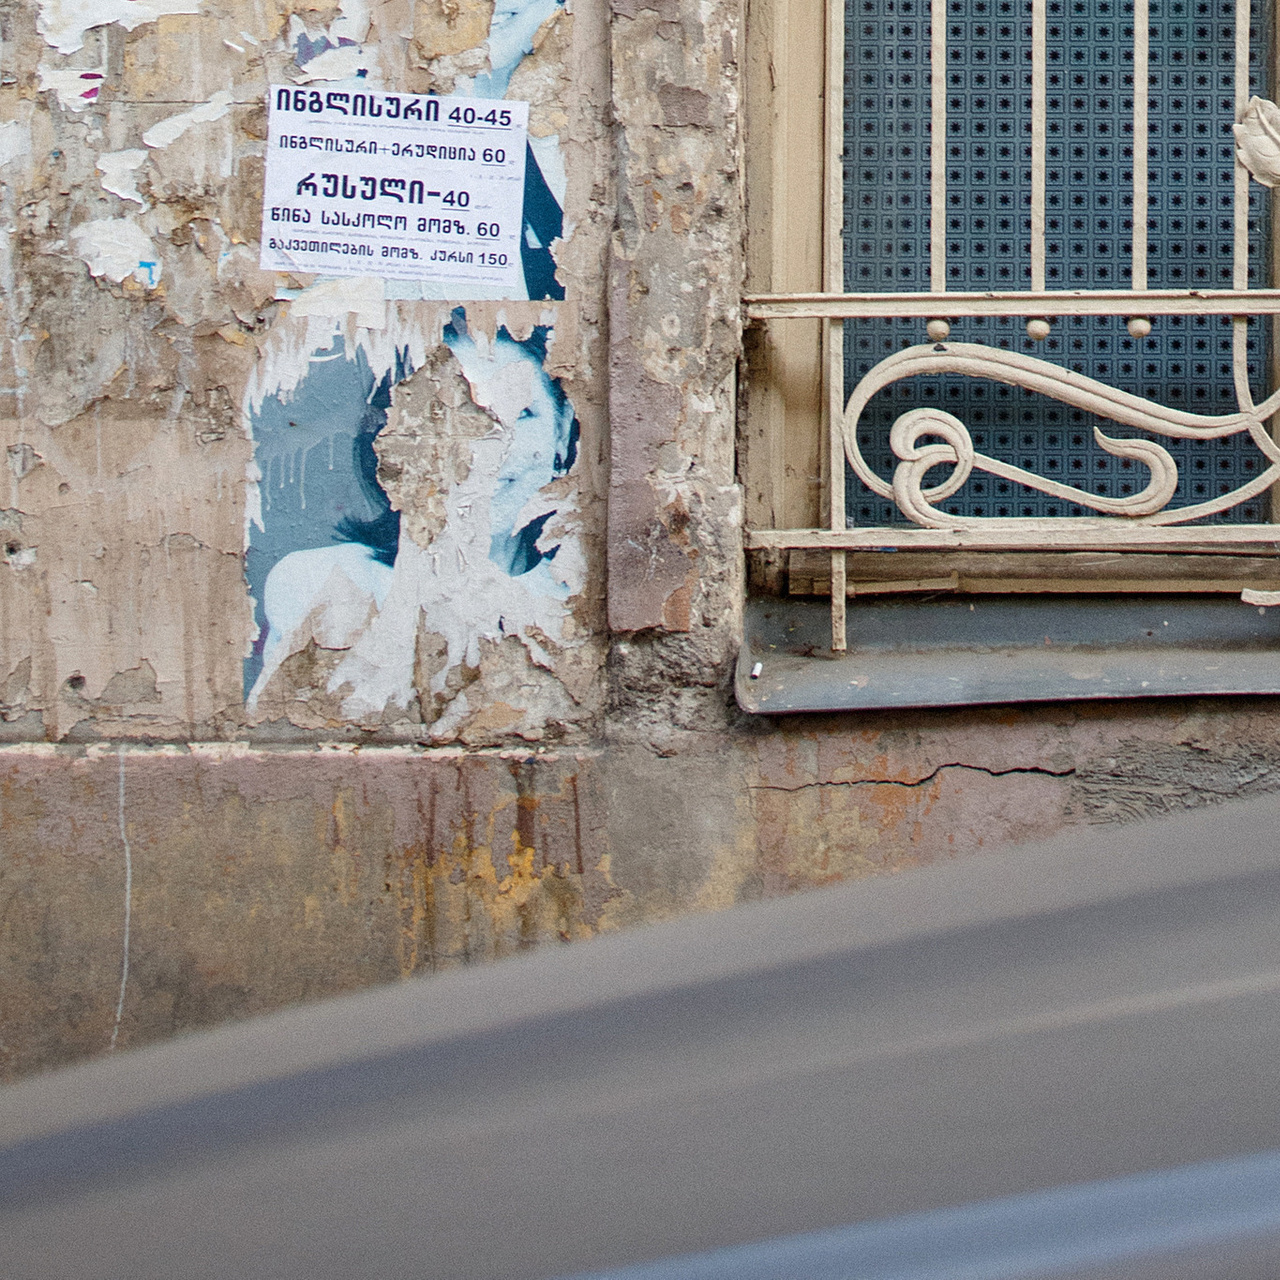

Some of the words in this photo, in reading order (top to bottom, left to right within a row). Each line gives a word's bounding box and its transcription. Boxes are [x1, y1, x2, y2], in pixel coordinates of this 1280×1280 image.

[276, 88, 440, 122] ინგლისური
[448, 106, 512, 128] 40-45
[482, 148, 506, 164] 60
[270, 207, 311, 224] წინა
[321, 210, 408, 232] სასკოლო
[476, 222, 500, 237] 60
[269, 237, 374, 257] გაკვეთილების
[430, 250, 474, 264] კურსი
[478, 253, 508, 267] 150
